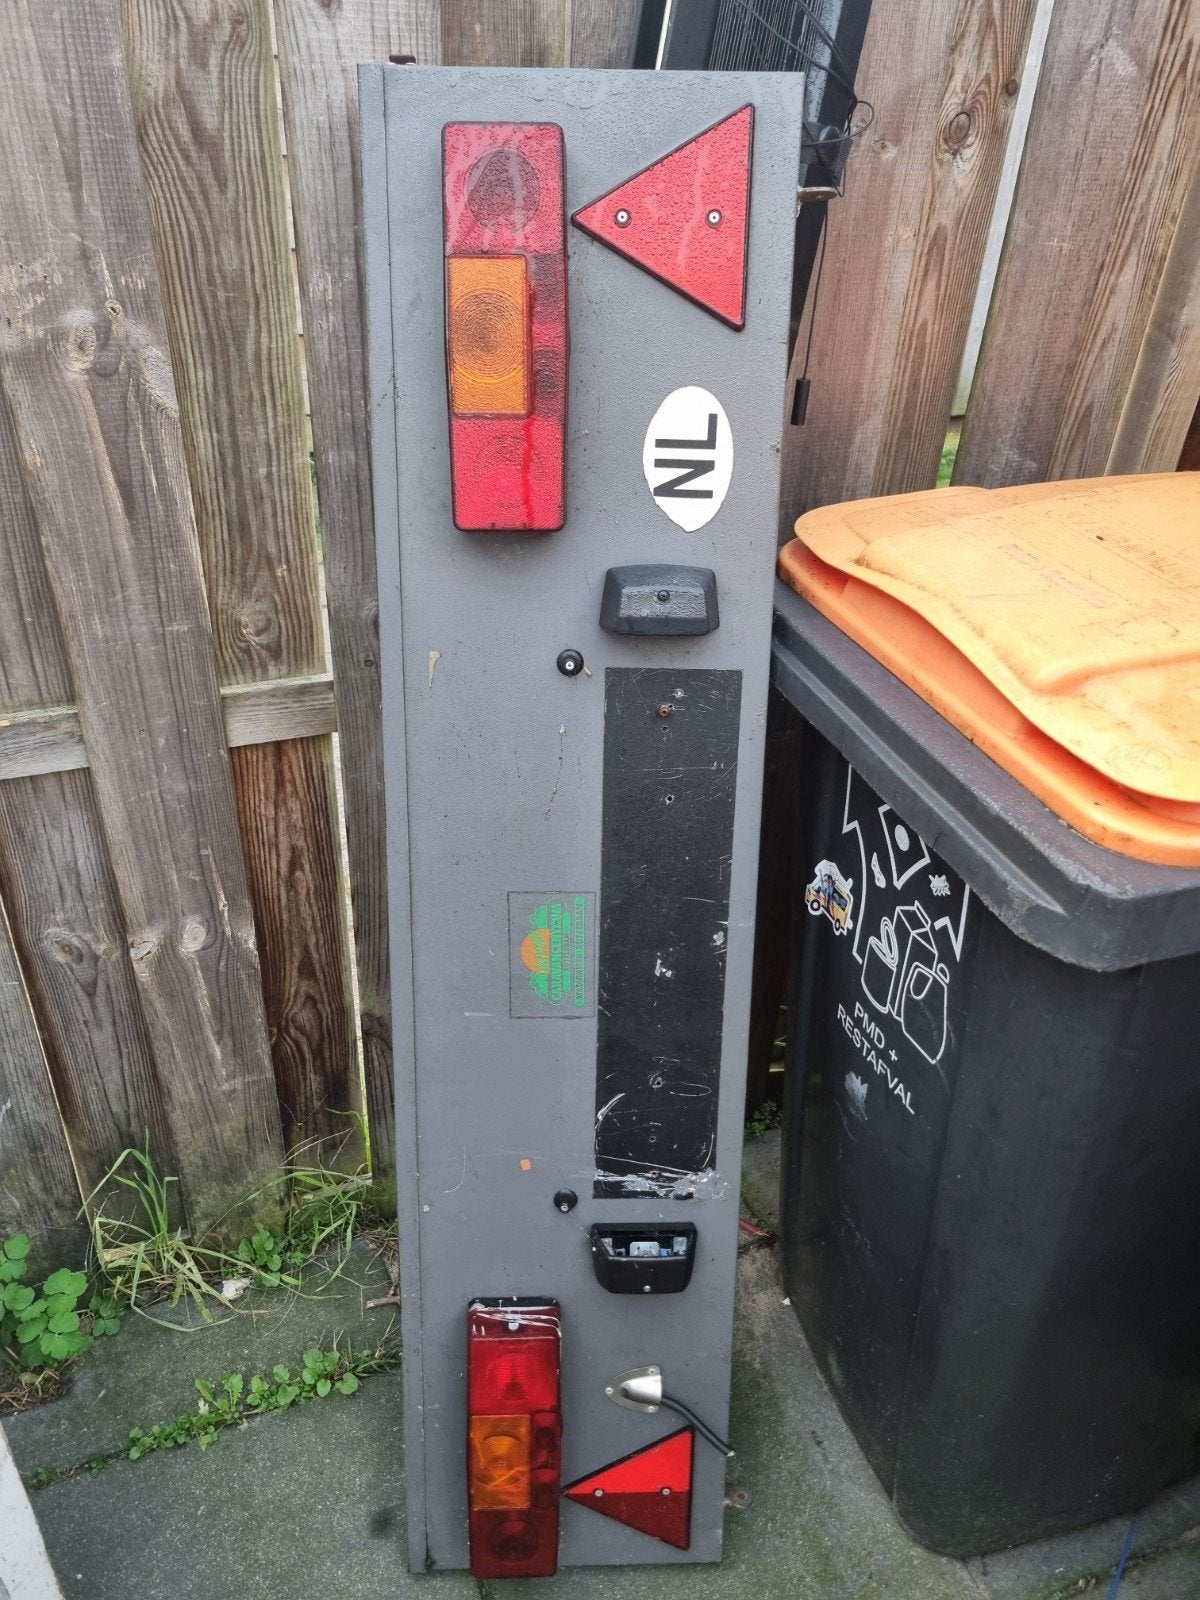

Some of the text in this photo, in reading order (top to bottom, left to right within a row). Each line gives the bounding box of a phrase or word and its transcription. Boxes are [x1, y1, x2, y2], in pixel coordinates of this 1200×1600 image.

[653, 413, 717, 499] NL
[836, 1003, 916, 1115] RESTAFVAL
[853, 1002, 886, 1049] PMD
